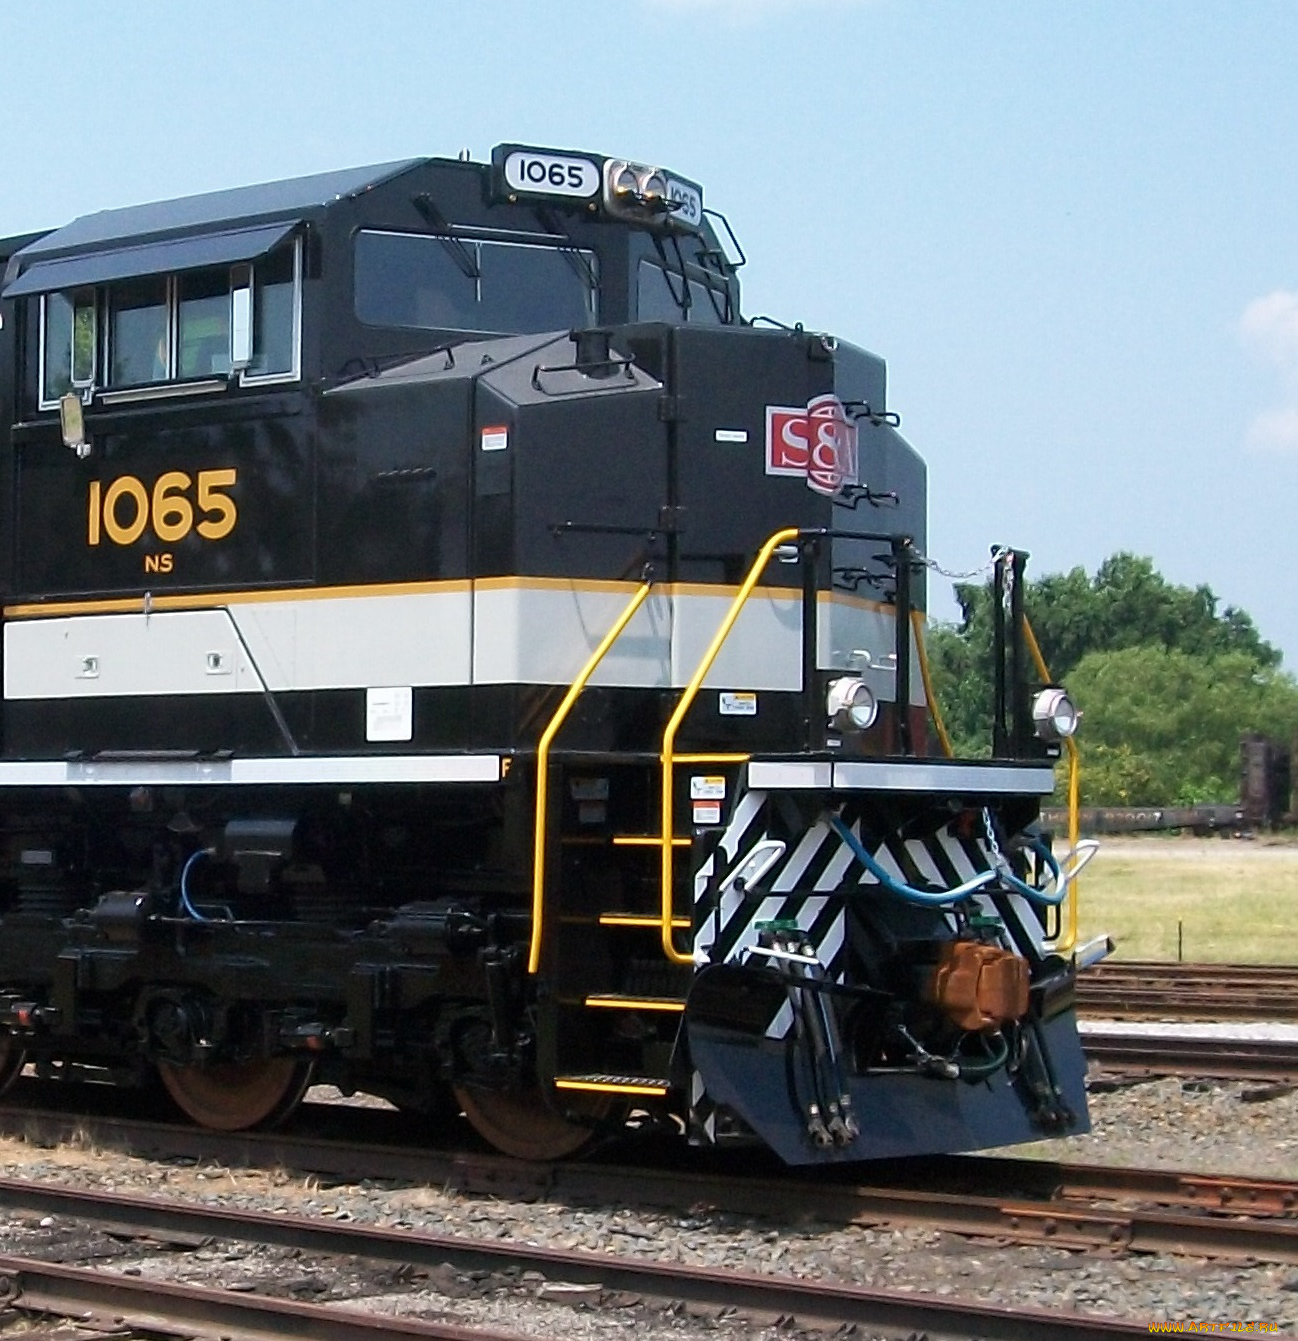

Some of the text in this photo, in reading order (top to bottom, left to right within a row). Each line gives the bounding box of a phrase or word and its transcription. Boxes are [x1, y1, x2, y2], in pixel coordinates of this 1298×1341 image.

[519, 158, 584, 189] 1065
[88, 468, 237, 545] 1065
[144, 553, 175, 573] NS
[501, 757, 512, 778] F
